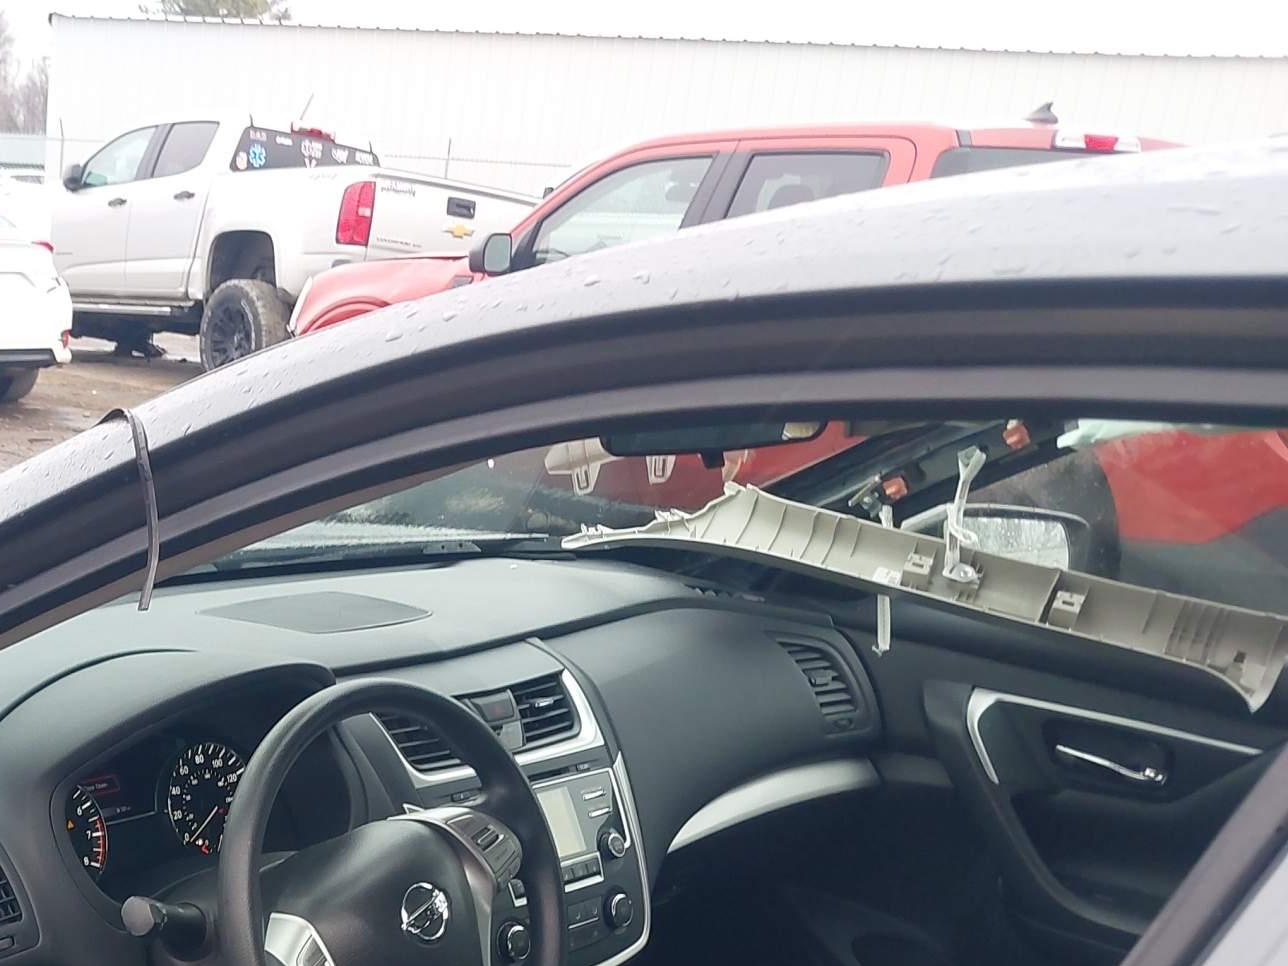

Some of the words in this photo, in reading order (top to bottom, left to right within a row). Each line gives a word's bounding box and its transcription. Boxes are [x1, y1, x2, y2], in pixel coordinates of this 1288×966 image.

[194, 754, 205, 765] 80
[212, 758, 223, 769] 100
[179, 765, 189, 776] 60
[226, 773, 238, 783] 120
[171, 785, 181, 796] 40
[76, 806, 82, 816] 6
[173, 809, 183, 820] 20
[85, 830, 92, 840] 7
[184, 832, 190, 842] 0
[83, 856, 90, 866] 8
